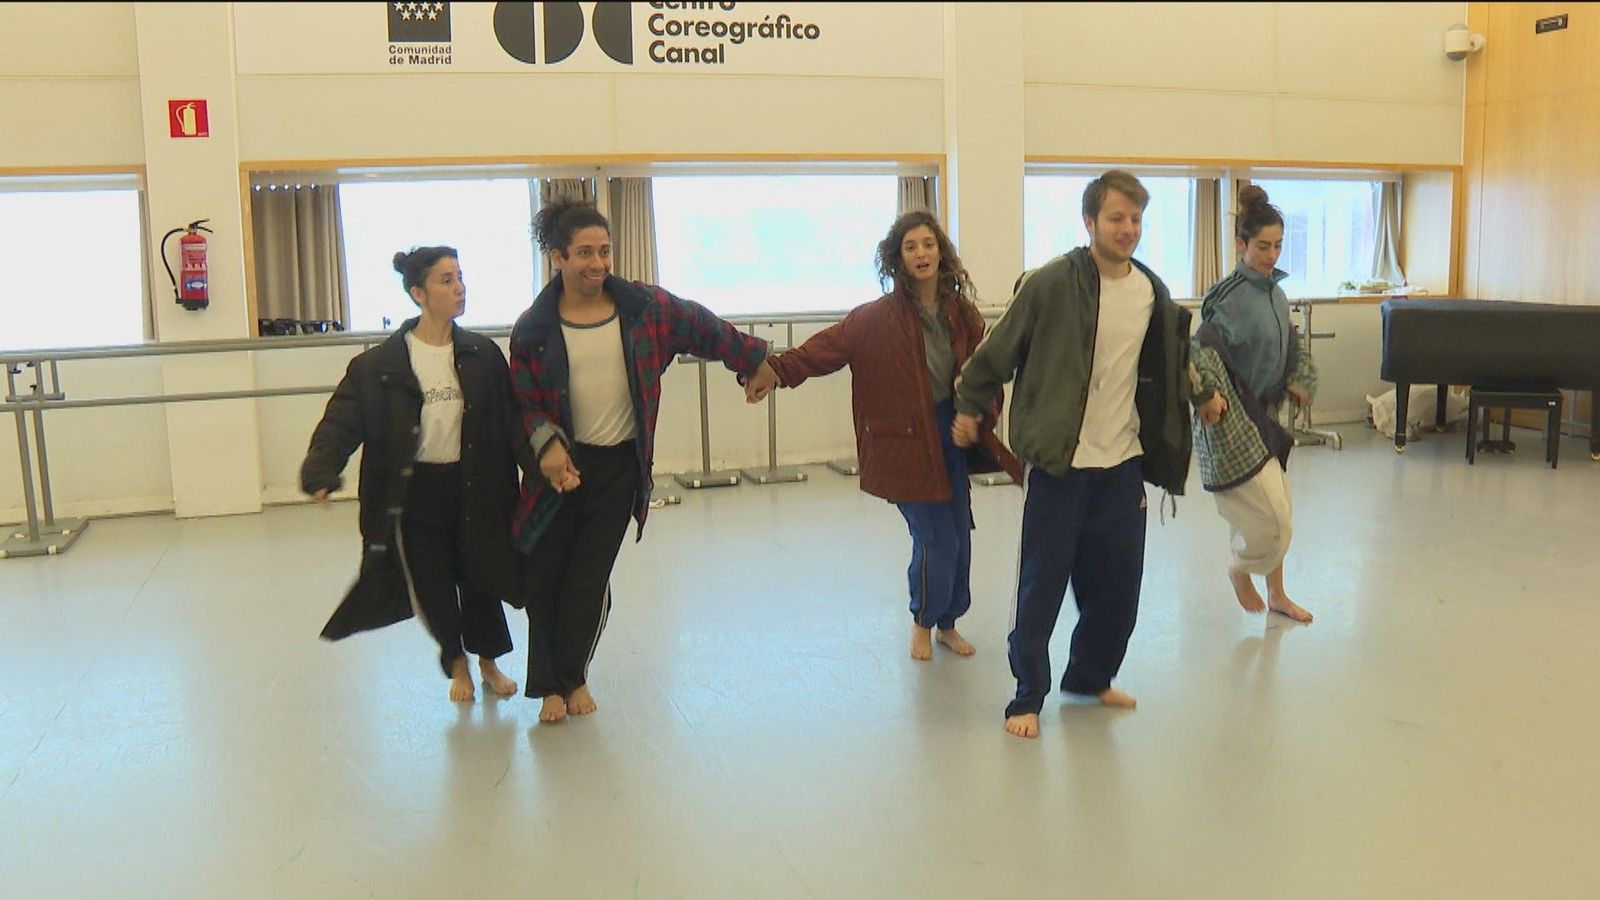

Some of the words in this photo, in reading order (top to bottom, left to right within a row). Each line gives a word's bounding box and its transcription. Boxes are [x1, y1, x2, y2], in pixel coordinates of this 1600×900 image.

[648, 13, 820, 44] Coreográfico
[388, 45, 452, 54] Comunidad
[649, 40, 725, 63] Canal
[389, 55, 404, 64] de
[408, 55, 452, 64] Madrid
